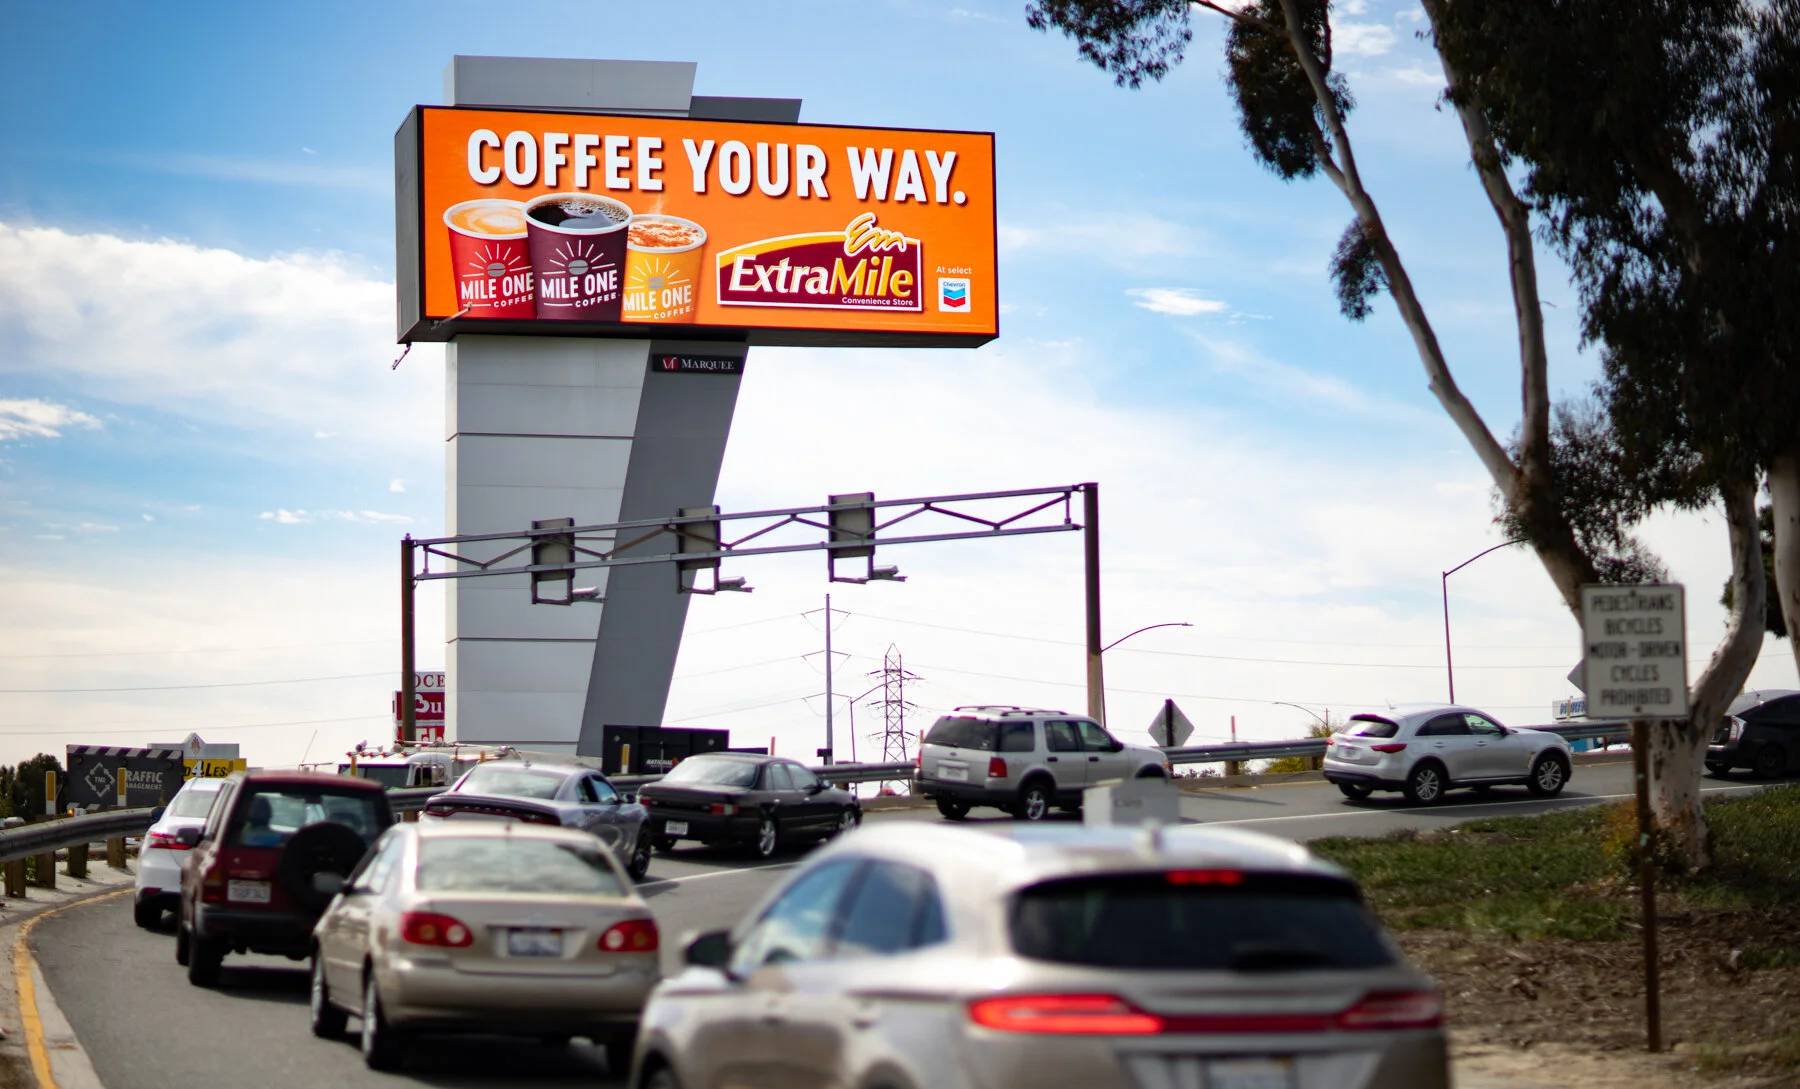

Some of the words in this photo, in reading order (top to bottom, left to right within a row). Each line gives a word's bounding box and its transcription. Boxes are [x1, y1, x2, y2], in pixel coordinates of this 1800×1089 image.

[467, 128, 663, 191] COFFEE
[681, 138, 830, 199] YOUR
[846, 146, 967, 204] WAY.
[728, 253, 914, 297] ExtraMile
[935, 266, 946, 274] At
[947, 266, 972, 275] select
[460, 276, 497, 301] MILE
[502, 271, 535, 298] ONE
[541, 276, 579, 300] MILE
[584, 268, 618, 296] ONE
[942, 280, 966, 288] Chevron
[493, 292, 534, 309] COFFEE
[575, 291, 617, 309] COFFEE
[623, 289, 657, 313] MILE
[661, 284, 692, 309] ONE
[841, 296, 891, 306] Convenience
[892, 298, 914, 307] Store
[653, 305, 691, 320] COFFEE
[681, 358, 735, 371] MARQUEE
[1590, 594, 1675, 612] PEDESTRIANS
[1604, 616, 1664, 636] BICYCLES
[1610, 664, 1660, 683] CYCLES
[1601, 687, 1672, 706] PROHIBITED
[125, 769, 164, 783] RAFFIC
[125, 782, 163, 790] ANAGEMENT
